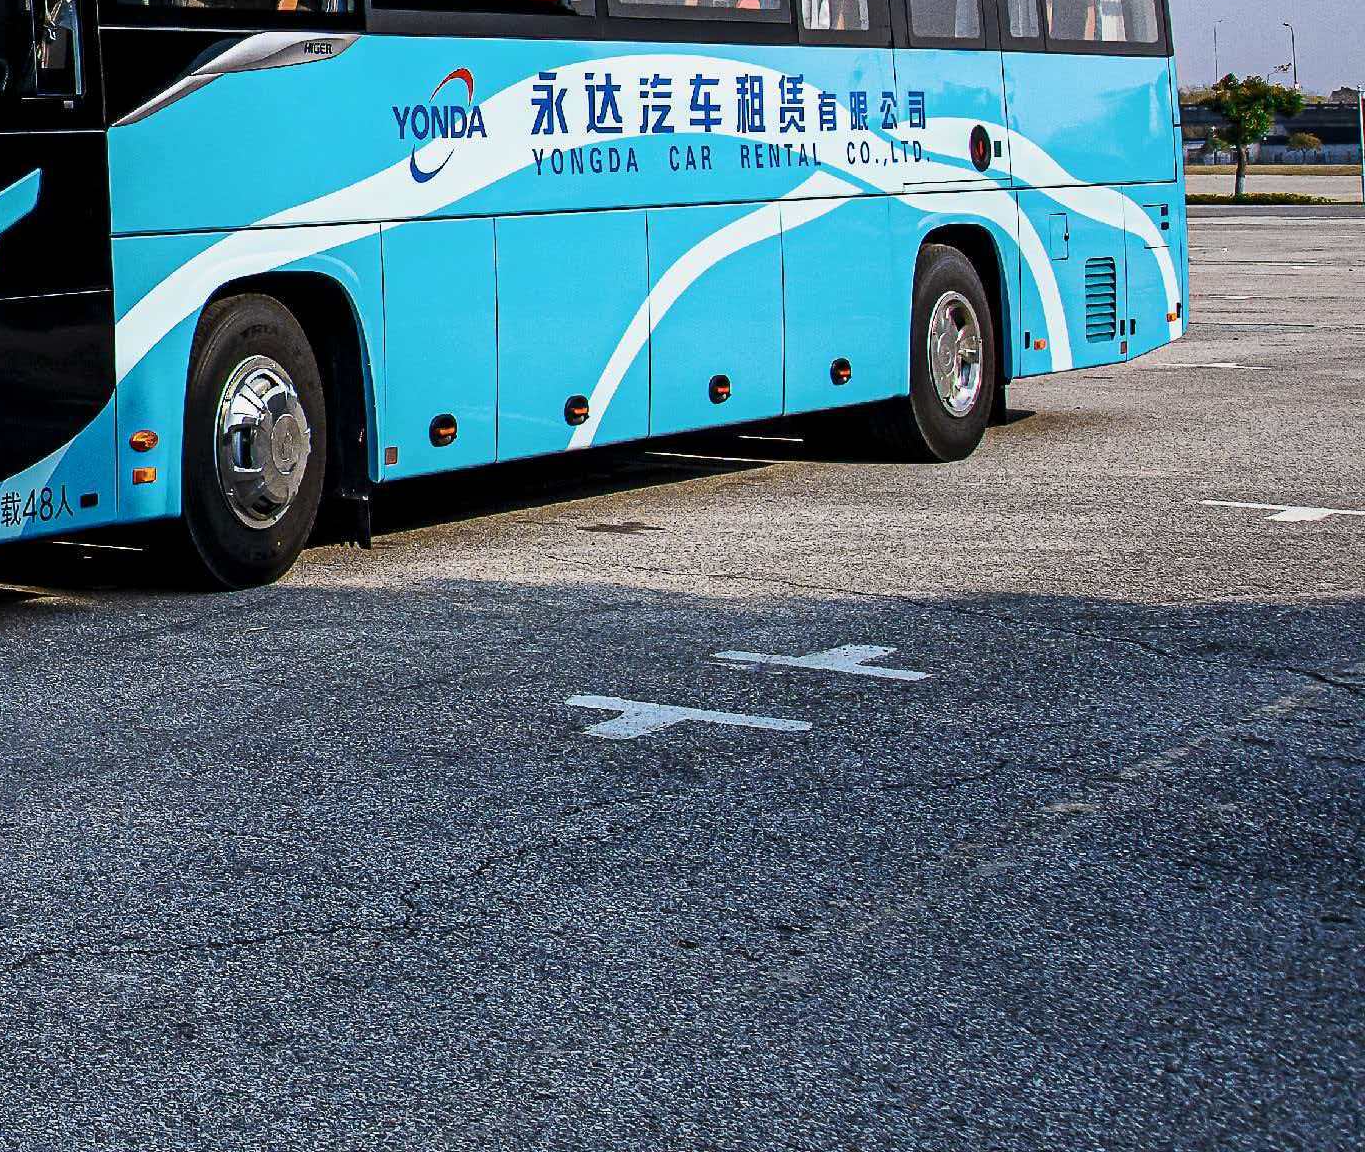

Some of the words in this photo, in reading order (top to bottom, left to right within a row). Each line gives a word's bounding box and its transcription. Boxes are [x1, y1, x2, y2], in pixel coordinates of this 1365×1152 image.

[531, 72, 926, 135] 永达汽车租赁有限公司
[392, 104, 488, 141] YONDA
[531, 147, 639, 176] YONGDA
[669, 145, 713, 172] CAR
[740, 142, 822, 169] RENTAL
